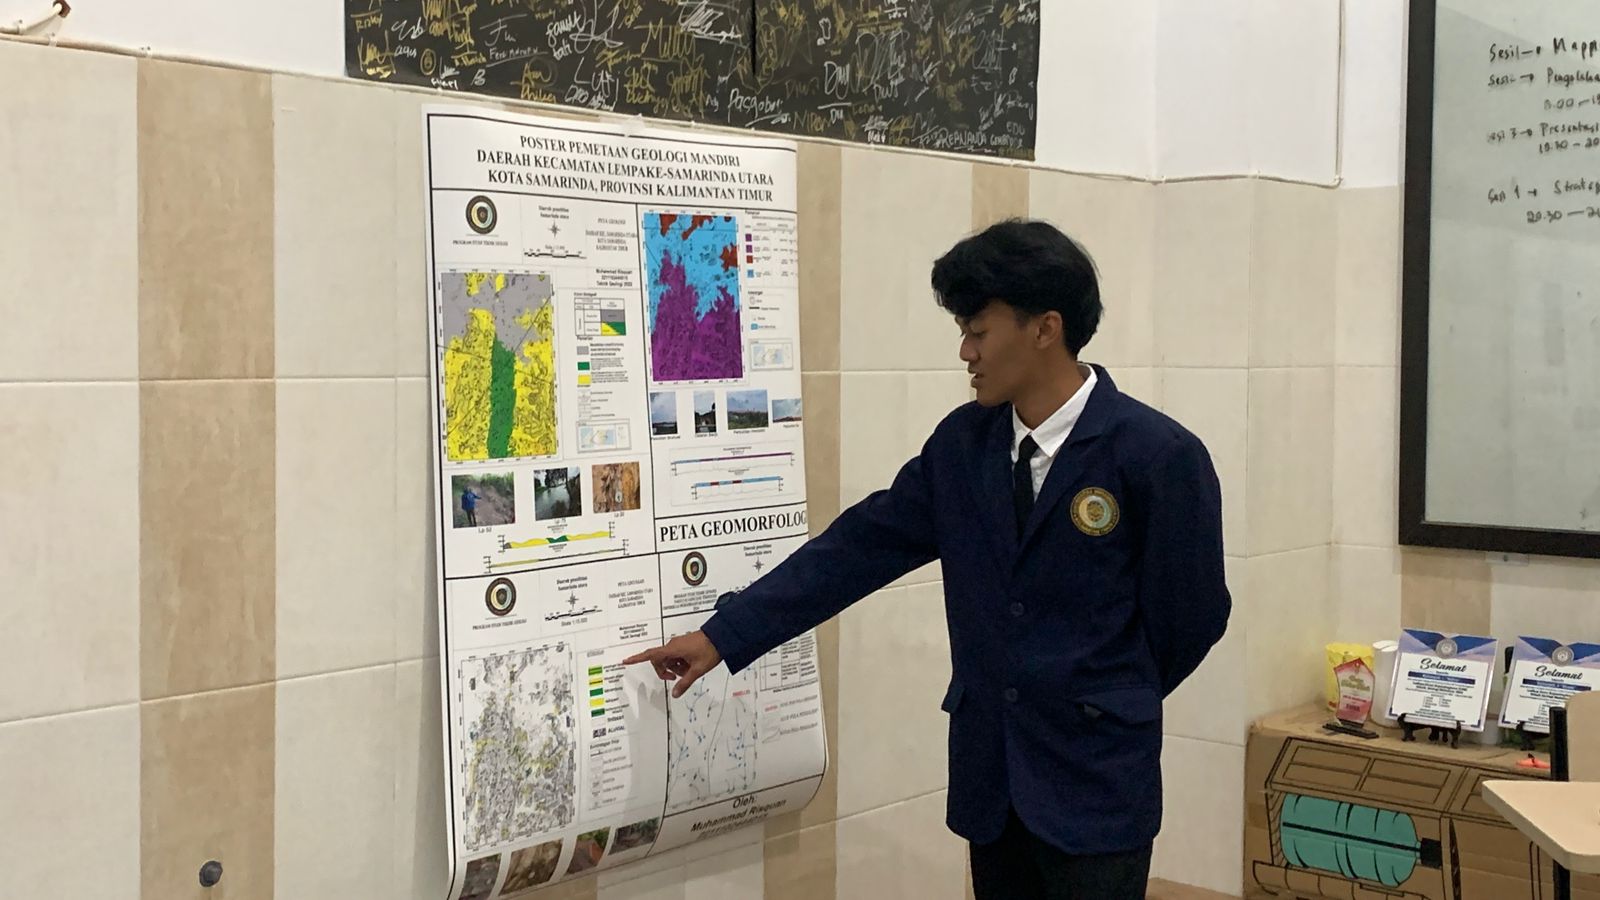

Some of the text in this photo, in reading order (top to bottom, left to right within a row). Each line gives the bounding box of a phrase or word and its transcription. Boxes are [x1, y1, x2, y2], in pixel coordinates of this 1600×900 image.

[520, 135, 741, 167] POSTER PEMETAAN GEOLOGI MANDIRI
[477, 148, 775, 187] DAERAH KECAMATAN LEMPAKE-SAMARINDA UTARA
[488, 169, 773, 202] KOTA SAMARINDA, PROVINSI KALIMANTAN TIMUR
[659, 522, 699, 543] PETA
[1420, 657, 1467, 673] Selamat
[1534, 665, 1583, 680] Selamat
